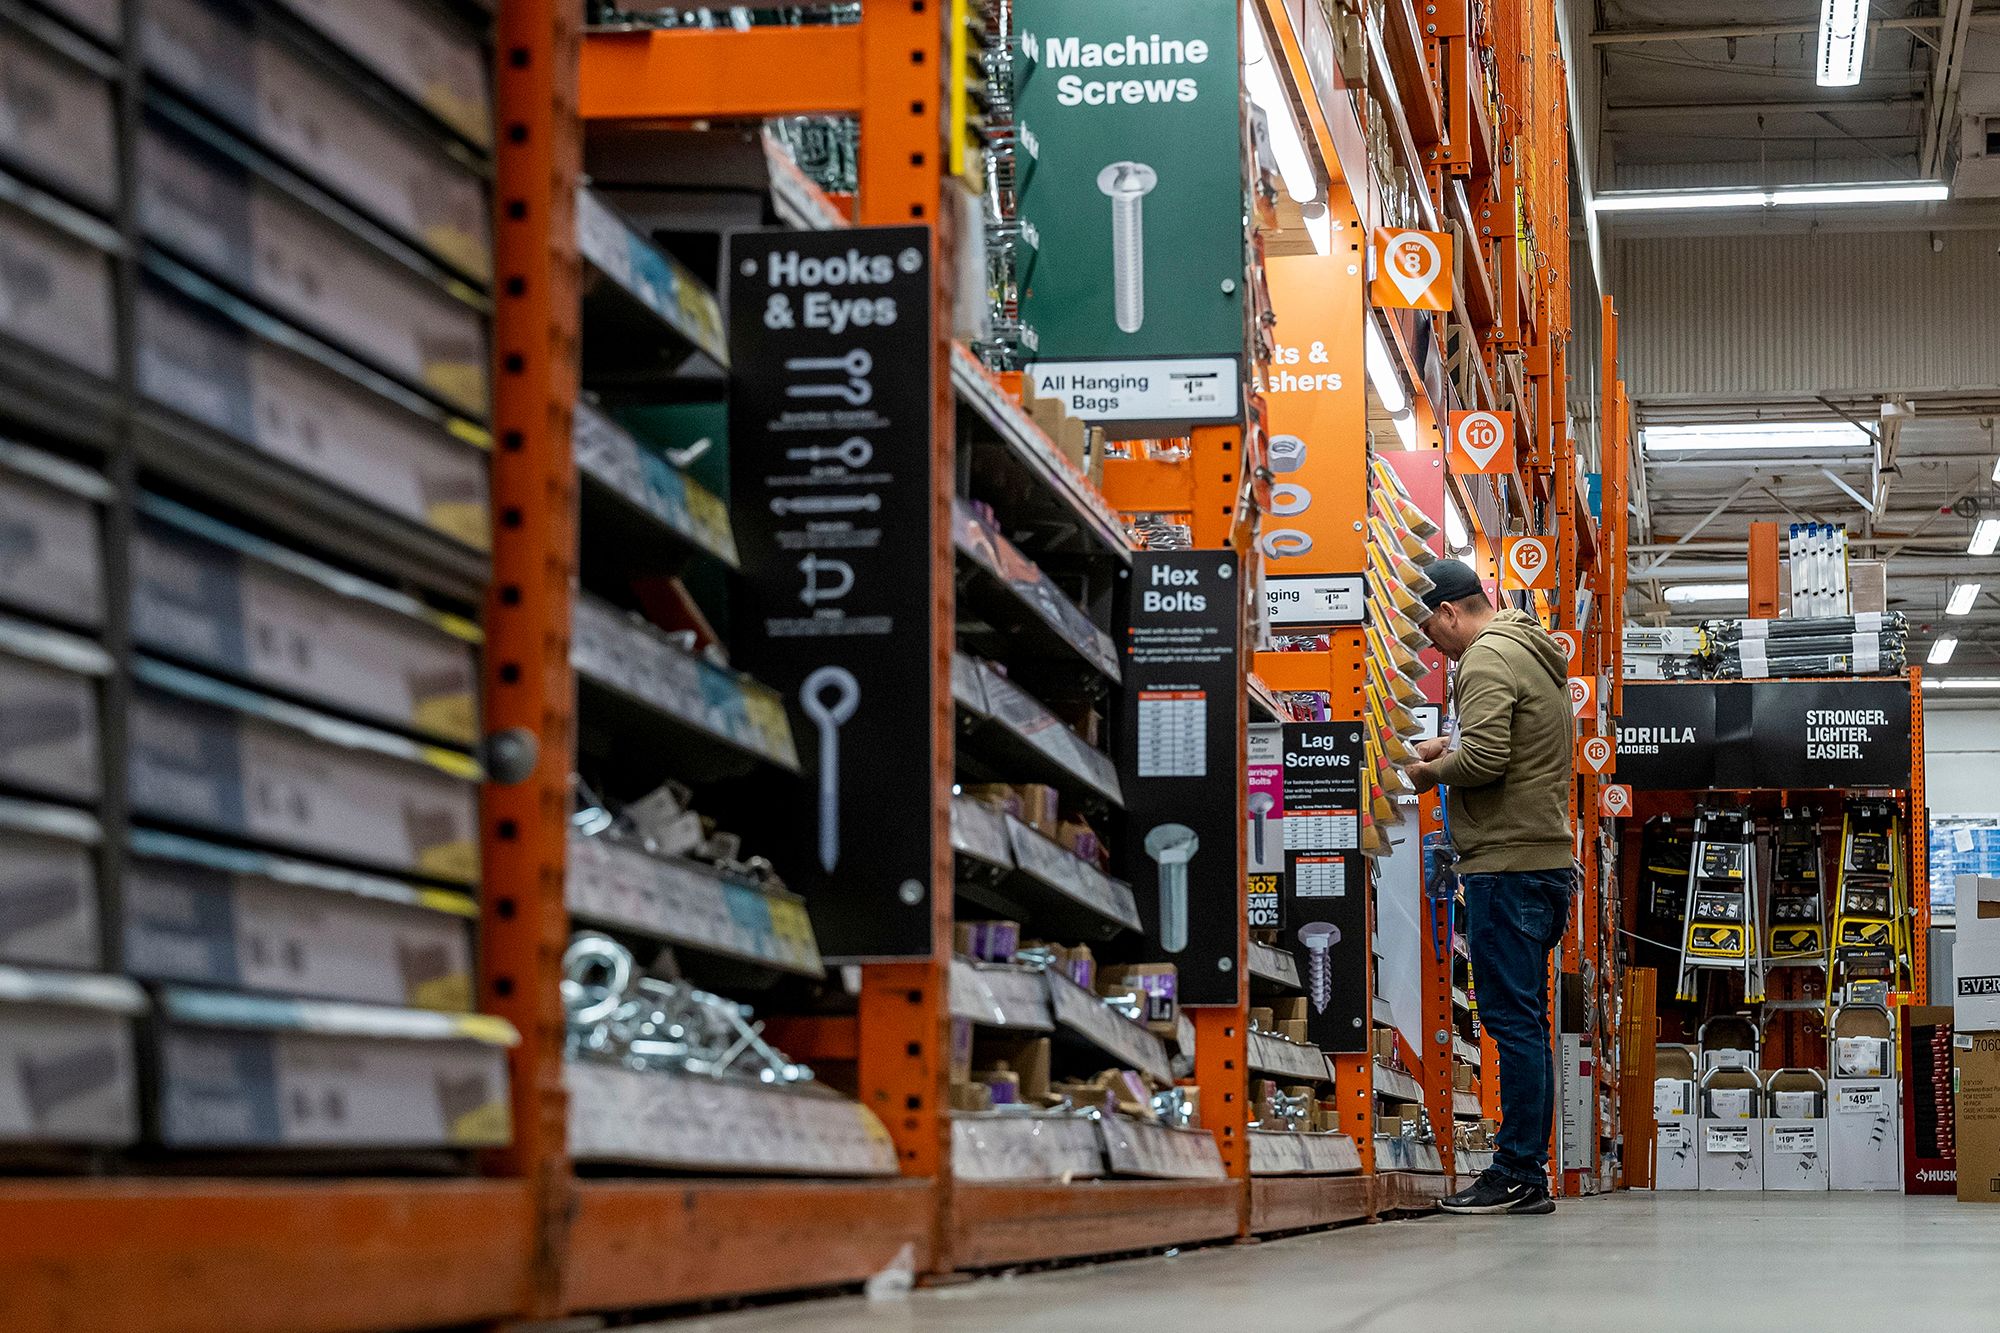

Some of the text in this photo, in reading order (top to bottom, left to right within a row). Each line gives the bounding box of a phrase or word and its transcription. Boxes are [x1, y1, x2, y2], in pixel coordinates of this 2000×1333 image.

[1046, 34, 1209, 68] Machine
[1057, 75, 1199, 106] Screws
[767, 248, 895, 287] Hooks
[1404, 253, 1421, 273] 8
[763, 291, 898, 334] & Eyes
[1274, 341, 1329, 365] ts &
[1042, 374, 1149, 392] All Hanging
[1252, 371, 1342, 393] ashers
[1072, 395, 1120, 413] Bags
[1470, 429, 1493, 444] 10
[1519, 552, 1538, 565] 12
[1151, 564, 1199, 586] Hex
[1143, 590, 1207, 612] Bolts
[1806, 710, 1888, 725] STRONGER.
[1250, 736, 1269, 744] Zinc
[1301, 733, 1334, 751] Lag
[1806, 727, 1872, 742] LIGHTER.
[1590, 748, 1604, 757] 18
[1615, 745, 1659, 754] ADDERS
[1806, 744, 1863, 759] EASIER.
[1285, 752, 1350, 767] Screws
[1248, 769, 1279, 777] arriage
[1248, 777, 1271, 785] Bolts
[1610, 794, 1622, 802] 20
[1248, 898, 1278, 909] SAVE
[1248, 909, 1279, 925] 10%
[1929, 1170, 1957, 1181] HUSK
